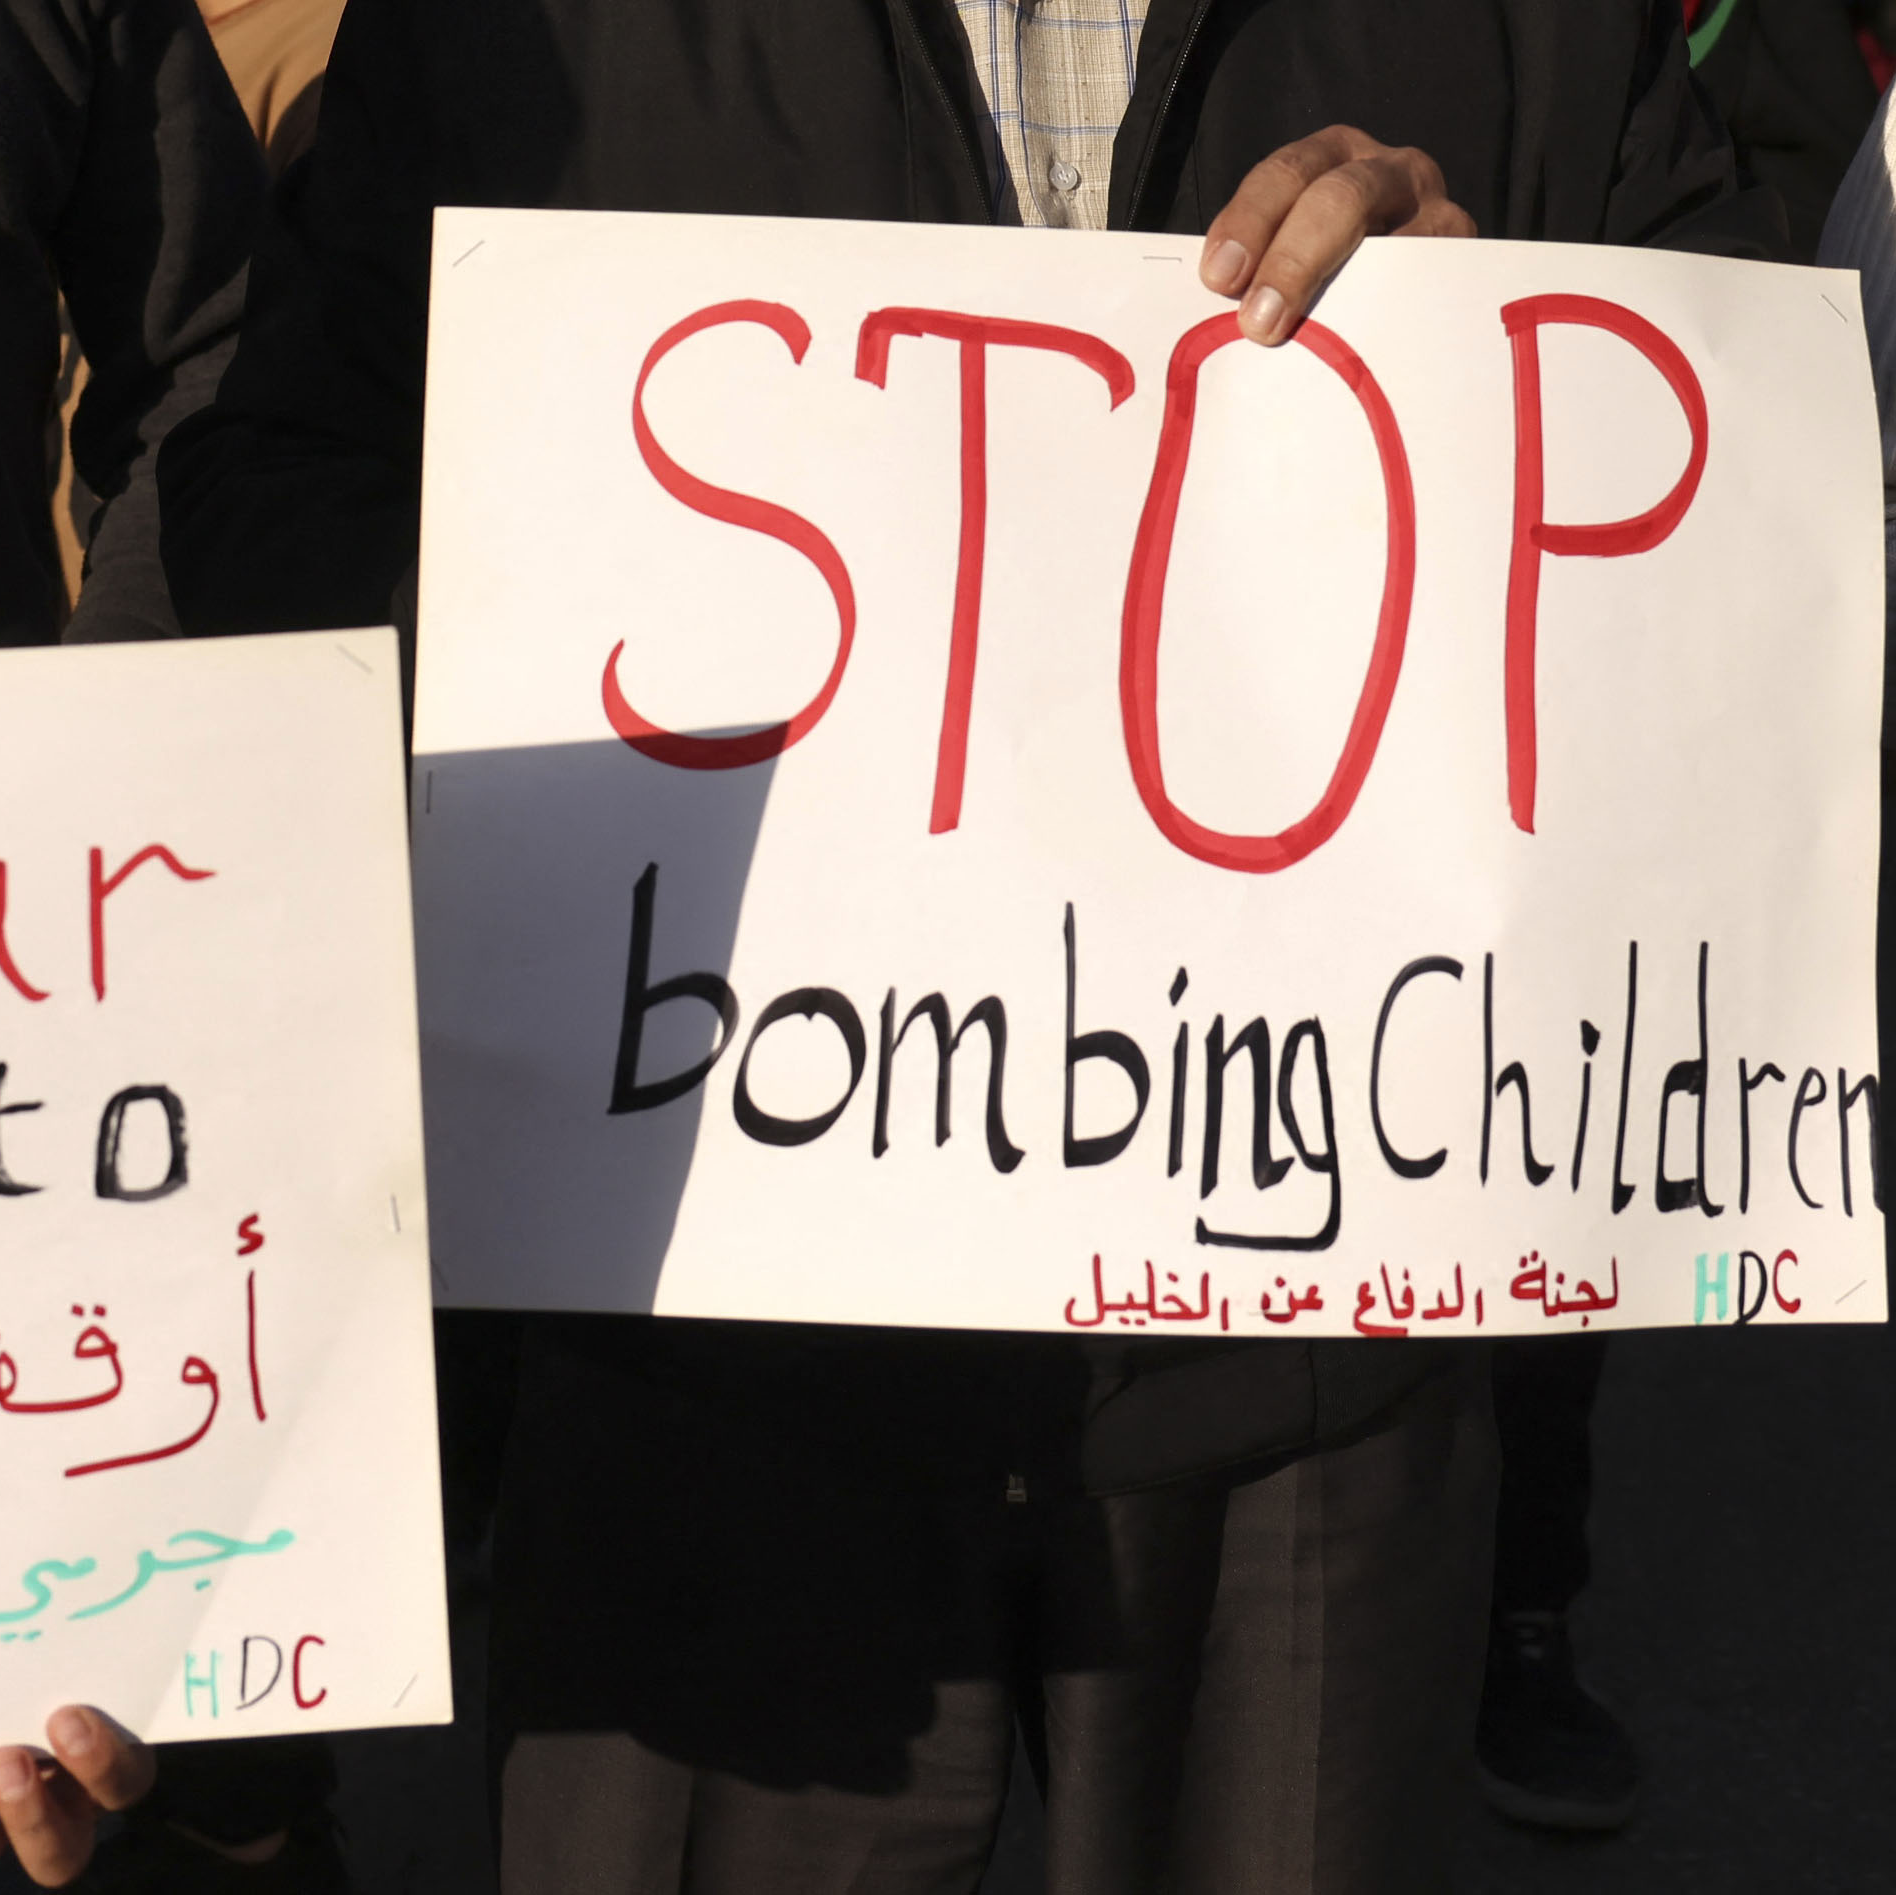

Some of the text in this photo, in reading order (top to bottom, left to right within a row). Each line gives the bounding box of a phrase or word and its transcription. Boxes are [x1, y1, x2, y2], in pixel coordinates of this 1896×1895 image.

[601, 293, 1710, 873] STOP
[606, 861, 1884, 1251] bombing Children
[1062, 1249, 1621, 1338] لجنة الدفاع عن الخليل
[1693, 1249, 1803, 1327] HDC
[184, 1634, 327, 1719] HDC
